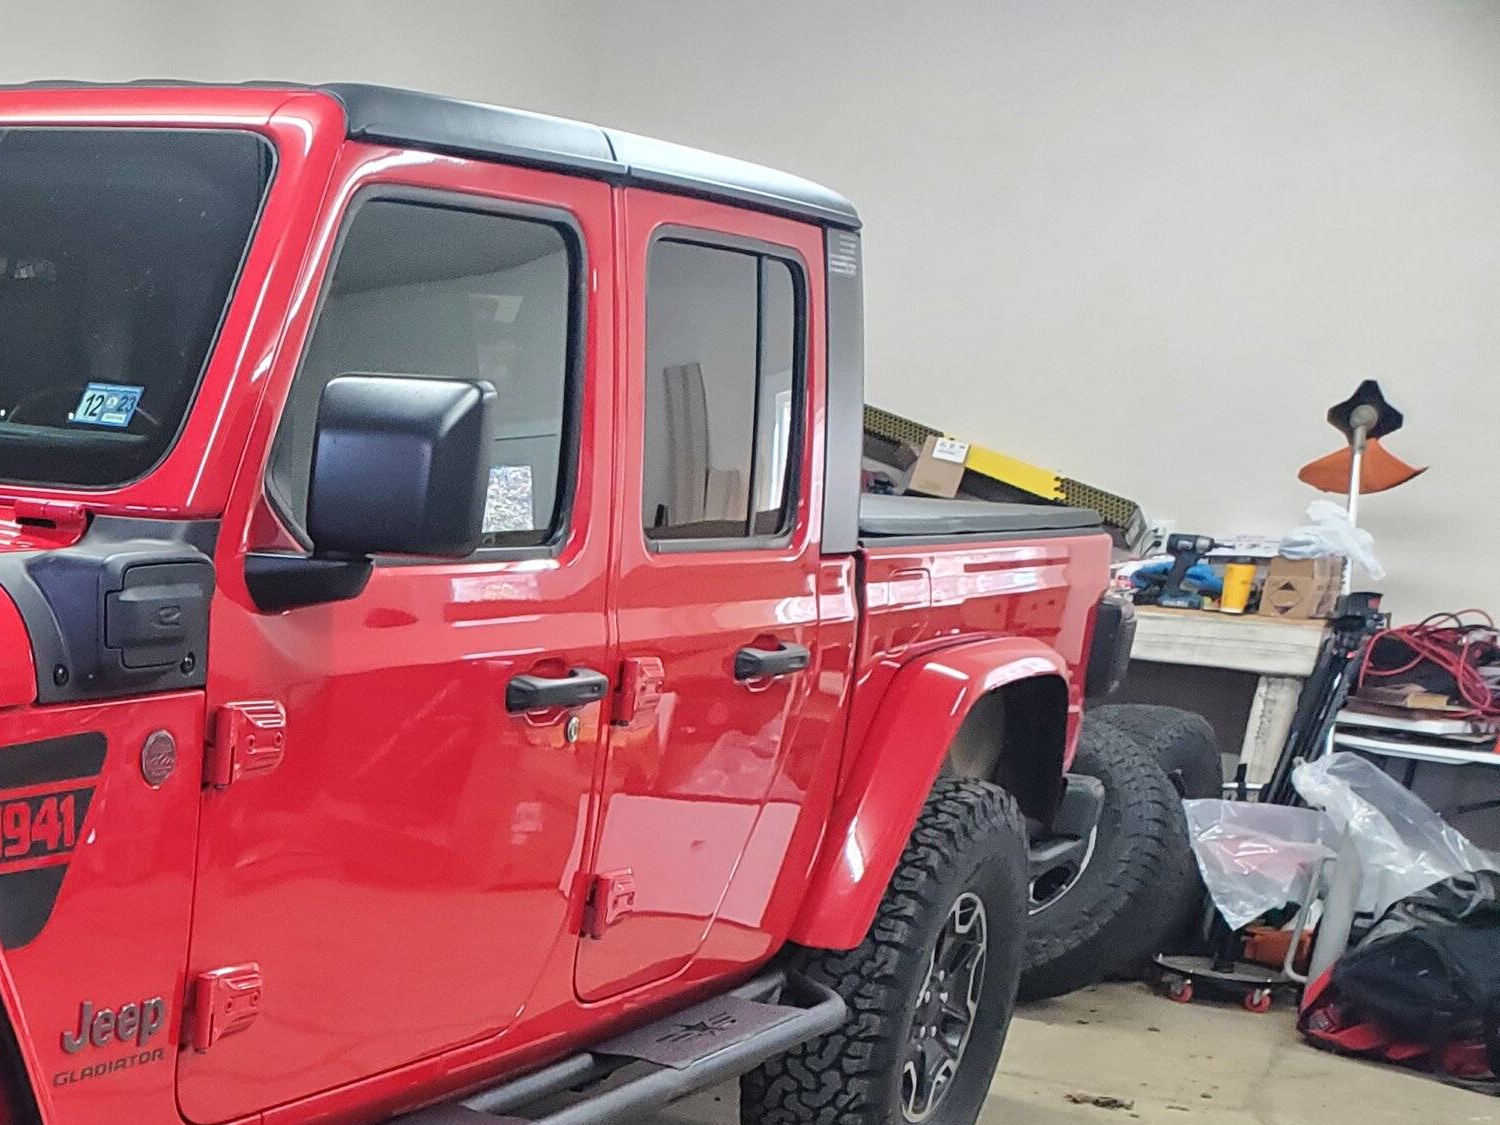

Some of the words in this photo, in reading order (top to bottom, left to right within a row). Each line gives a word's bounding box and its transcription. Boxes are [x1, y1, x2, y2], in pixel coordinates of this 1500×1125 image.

[84, 393, 104, 417] 12
[60, 995, 165, 1055] Jeep
[52, 1047, 165, 1088] GLADIATOR
